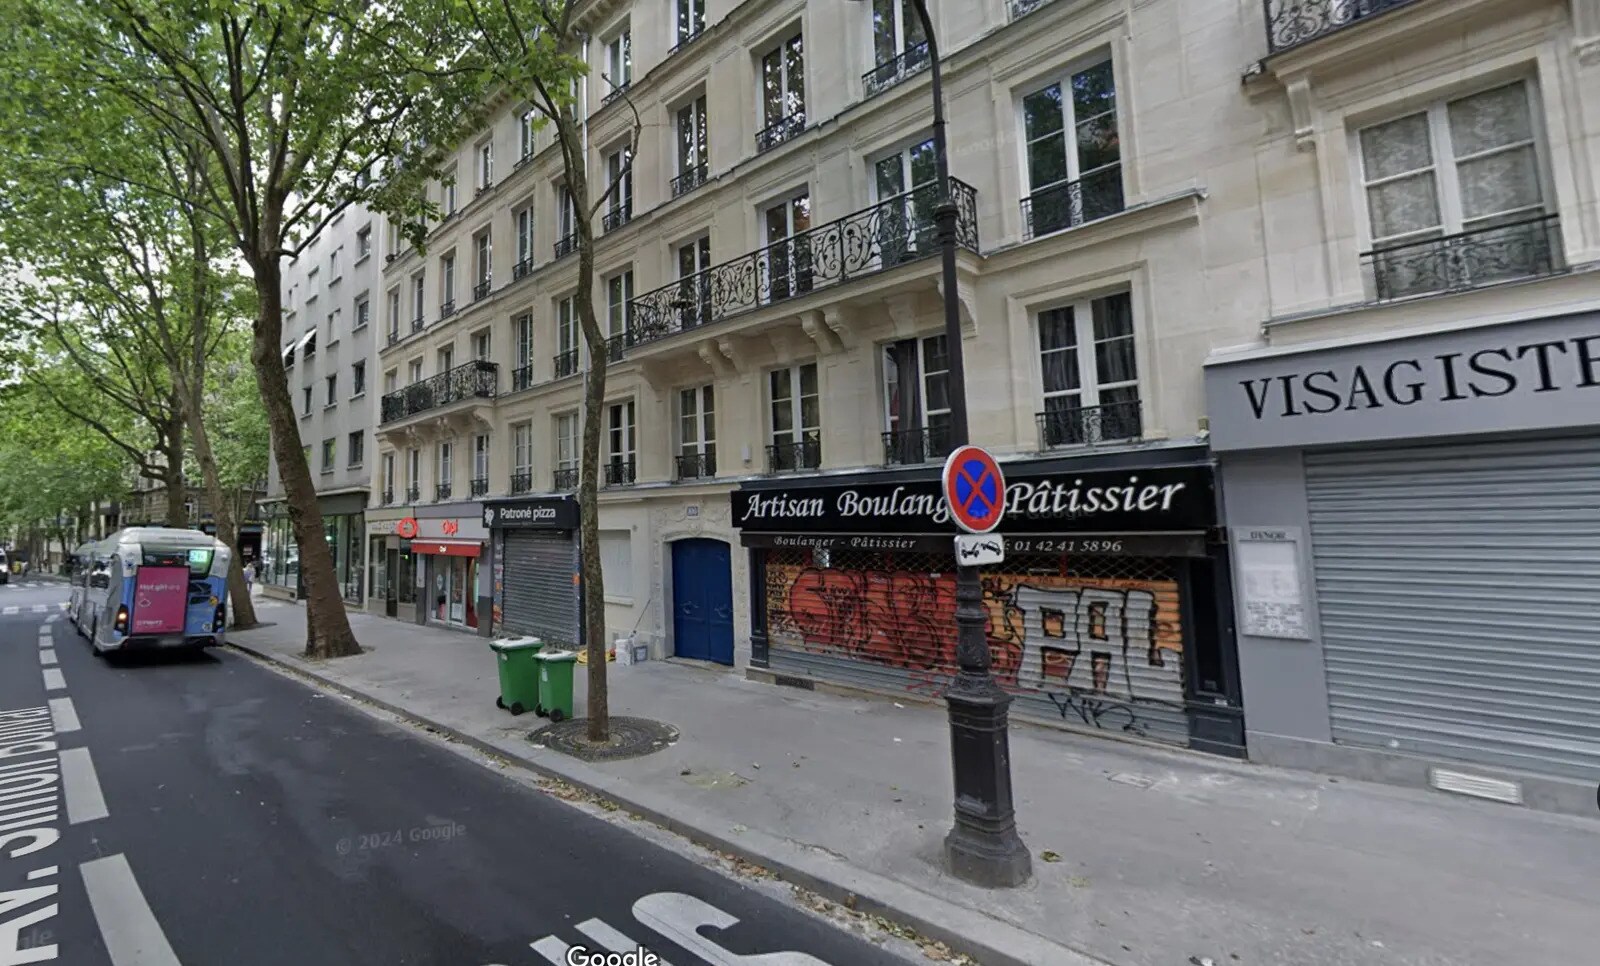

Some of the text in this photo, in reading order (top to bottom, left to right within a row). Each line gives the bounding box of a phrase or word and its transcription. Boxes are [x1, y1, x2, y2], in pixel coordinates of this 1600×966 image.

[741, 476, 1186, 524] Artisan Boulang Pâtissier
[500, 505, 556, 521] Patroné pizza
[774, 536, 835, 550] Boulanger
[851, 537, 916, 549] Pâtissier
[1014, 540, 1031, 552] 01
[1036, 540, 1053, 552] 42
[1057, 540, 1075, 552] 41
[1101, 540, 1122, 552] 96
